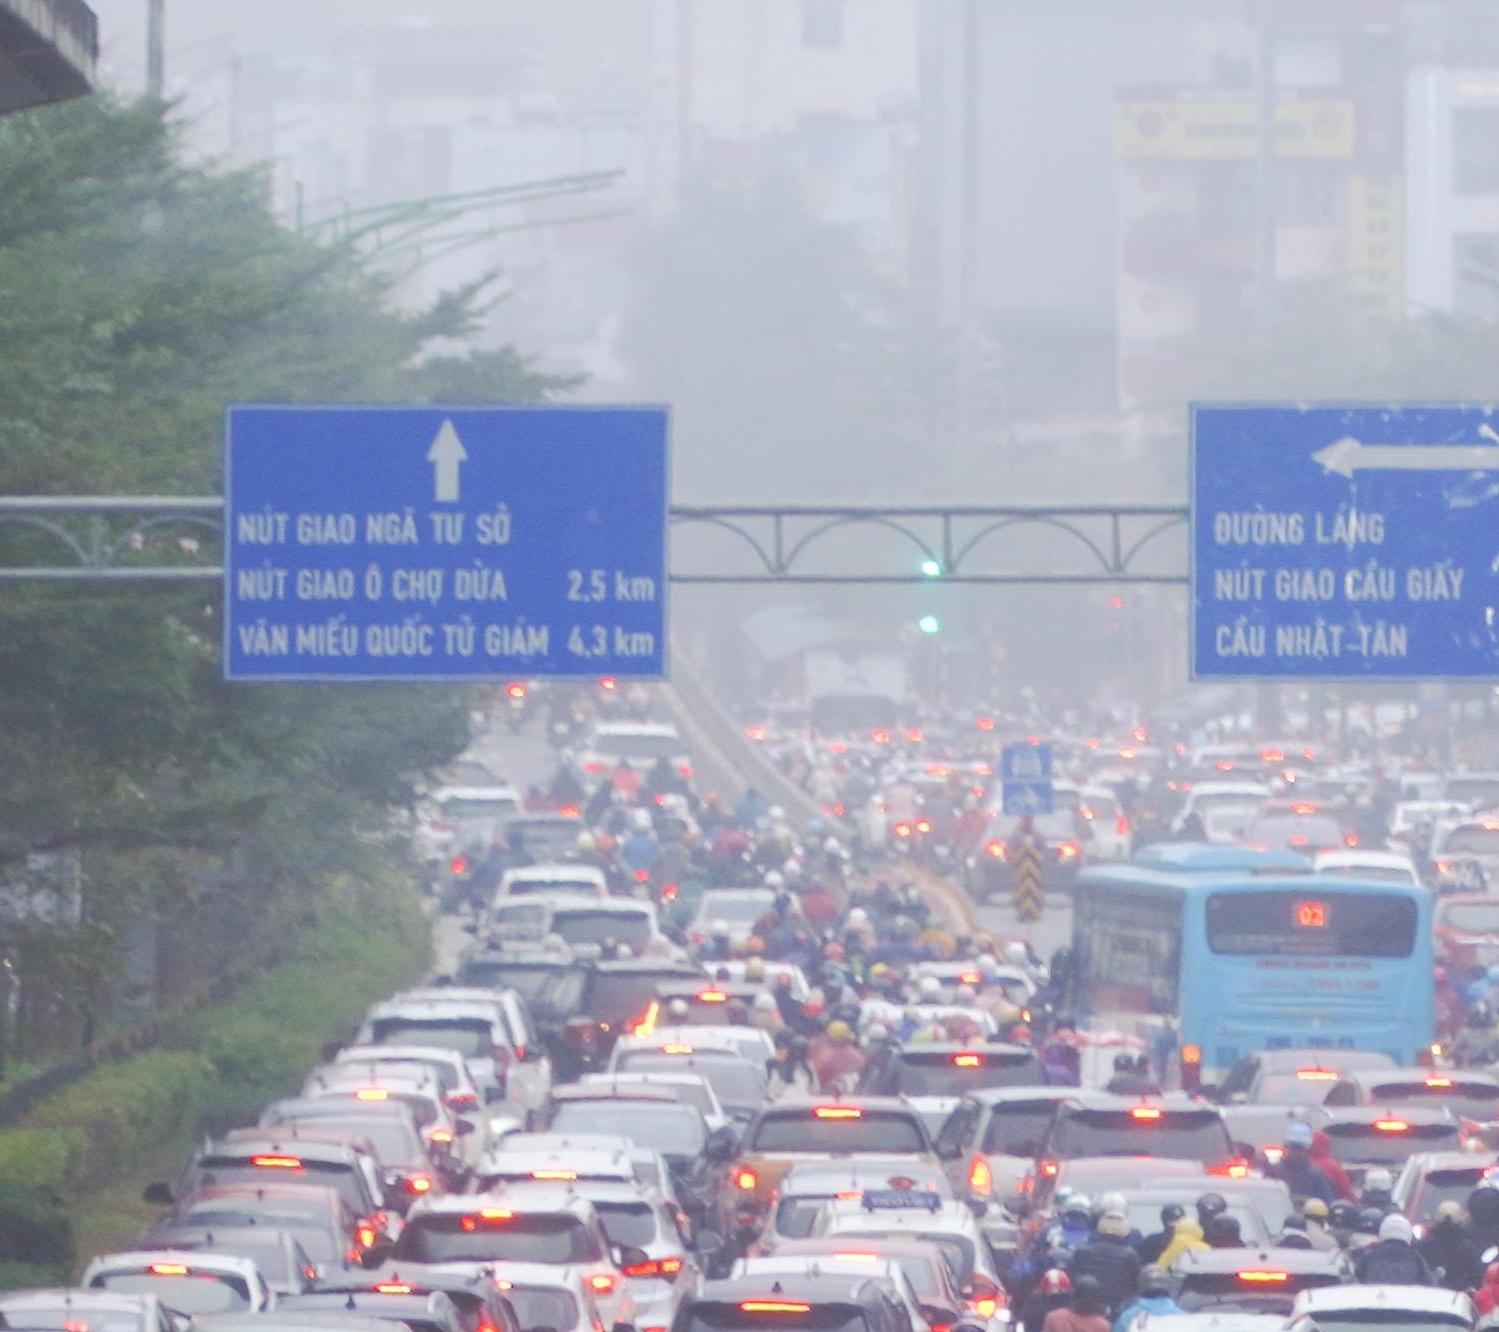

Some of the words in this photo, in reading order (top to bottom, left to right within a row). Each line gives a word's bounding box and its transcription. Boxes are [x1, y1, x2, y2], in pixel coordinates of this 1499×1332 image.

[238, 506, 287, 543] NÚT
[298, 513, 355, 543] GIAO
[366, 506, 418, 543] NGÃ
[430, 511, 464, 543] TƯ
[476, 504, 512, 543] SỞ
[1214, 504, 1303, 544] ĐƯỜNG
[238, 560, 287, 600] NÚT
[298, 569, 354, 600] GIAO
[365, 563, 381, 600] Ô
[392, 569, 443, 606] CHỢ
[455, 560, 506, 600] DỪA
[615, 570, 654, 600] km
[1214, 560, 1265, 600] NÚT
[1275, 569, 1335, 600] GIAO
[1345, 559, 1395, 600] CẦU
[1407, 558, 1464, 600] GIẤY
[239, 618, 287, 656] VĂN
[297, 614, 357, 656] MIẾU
[366, 614, 433, 656] QUỐC
[442, 616, 475, 656] TỬ
[484, 616, 549, 656] GIÁM
[615, 626, 654, 655] km
[1216, 615, 1264, 656] CẦU
[1276, 616, 1344, 659] NHẬT
